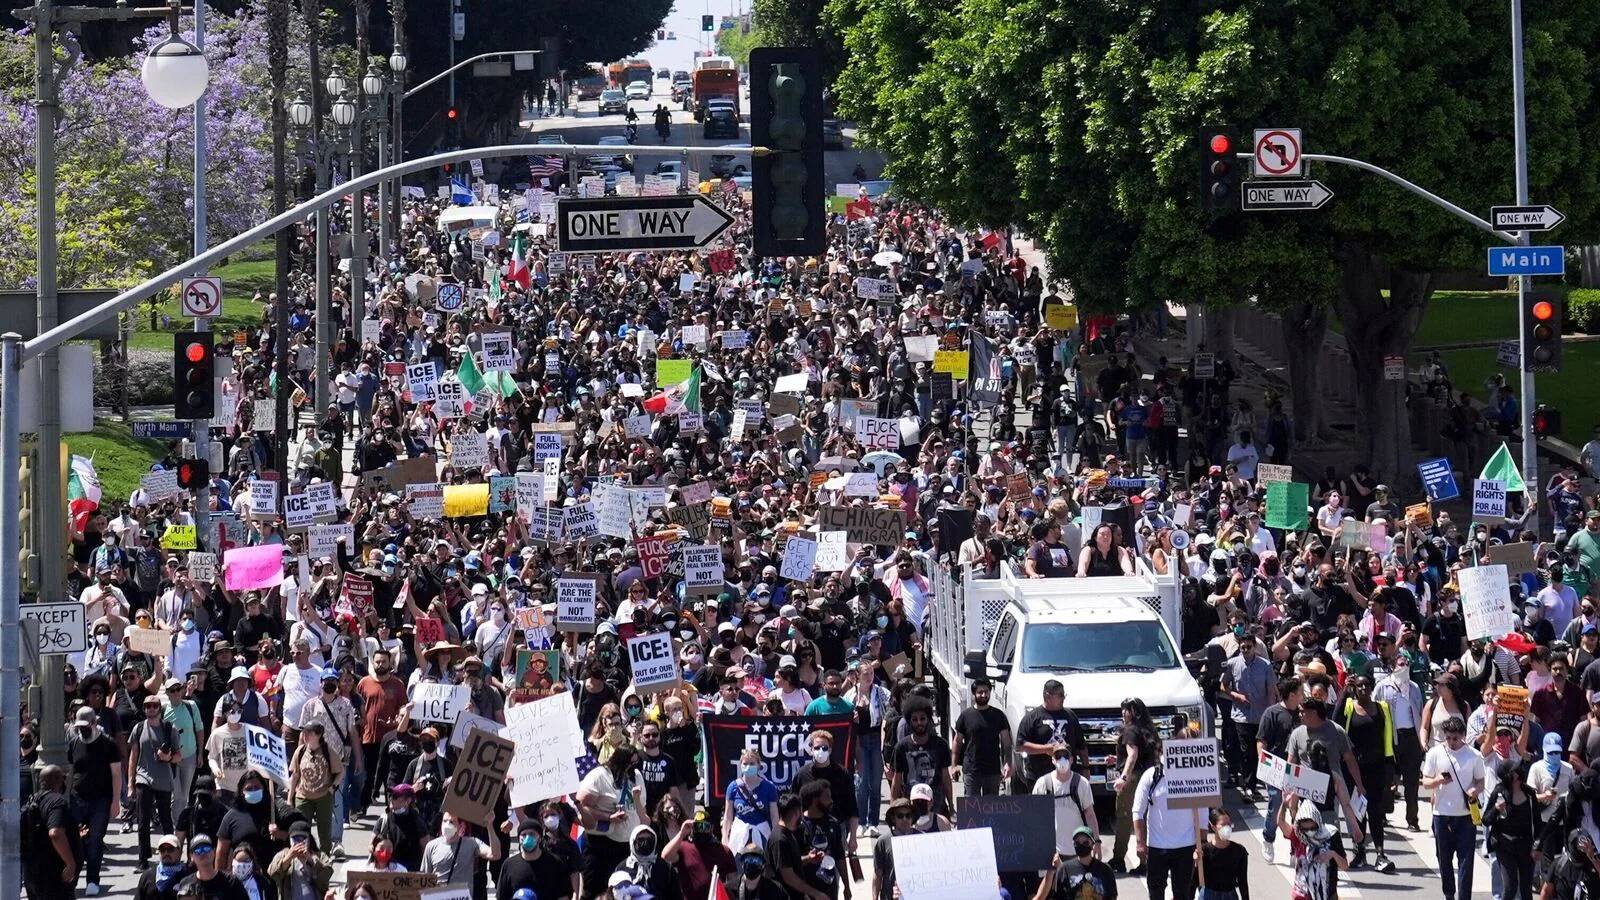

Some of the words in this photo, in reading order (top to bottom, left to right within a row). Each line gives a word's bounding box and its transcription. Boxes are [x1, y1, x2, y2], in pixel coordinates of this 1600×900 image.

[1249, 190, 1276, 201] ONE
[1284, 188, 1311, 200] WAY
[571, 213, 620, 236] ONE
[639, 211, 690, 234] WAY
[1500, 214, 1520, 223] ONE
[1523, 214, 1543, 222] WAY
[1502, 252, 1550, 266] Main
[486, 360, 512, 368] DEVIL!
[409, 366, 433, 378] ICE
[438, 384, 460, 394] ICE
[134, 422, 155, 431] North
[160, 422, 177, 431] Main
[866, 419, 898, 434] FUCK
[866, 433, 898, 449] ICE
[1480, 482, 1500, 490] FULL
[1476, 490, 1504, 500] RIGHTS
[569, 506, 588, 516] FULL
[567, 512, 594, 525] RIGHTS
[570, 528, 584, 536] FOR
[820, 533, 842, 543] ICE
[638, 541, 667, 558] FUCK
[788, 539, 812, 550] GET
[784, 559, 809, 570] FUCK
[193, 568, 211, 579] ICE
[785, 568, 804, 578] OUT
[26, 610, 76, 623] EXCEPT
[632, 638, 669, 662] ICE:
[636, 672, 673, 683] COMMUNITIES!
[424, 700, 454, 720] I.C.E.
[249, 730, 283, 759] ICE:
[745, 733, 812, 758] FUCK
[467, 736, 514, 774] ICE
[1166, 745, 1214, 757] ¡DERECHOS
[1166, 755, 1214, 769] PLENOS
[454, 768, 500, 806] OUT
[1168, 786, 1217, 794] INMIGRANTES!
[393, 876, 413, 887] ONE
[420, 877, 436, 888] US
